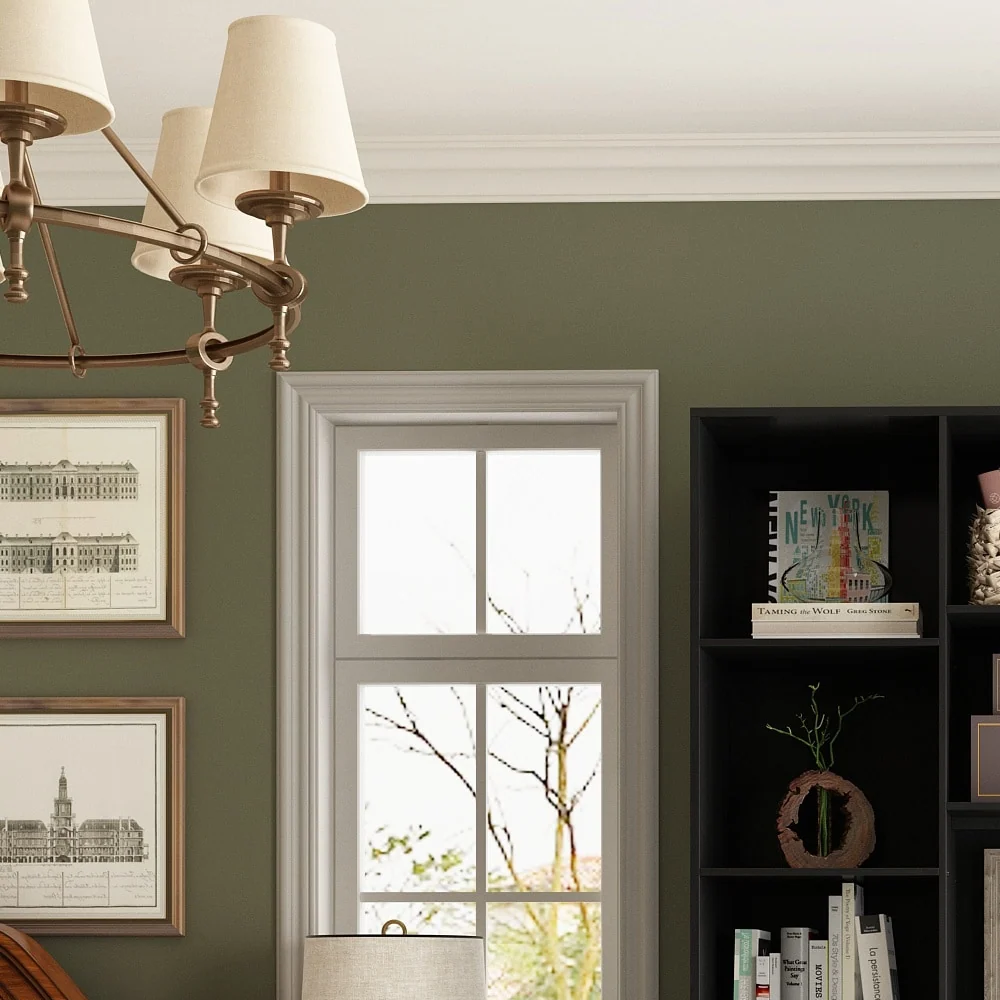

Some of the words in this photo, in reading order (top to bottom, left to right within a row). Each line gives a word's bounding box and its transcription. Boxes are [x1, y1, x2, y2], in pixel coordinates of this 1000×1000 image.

[785, 499, 824, 545] NEW
[799, 607, 811, 615] the
[831, 933, 839, 947] 70s
[830, 947, 839, 968] Style
[868, 947, 879, 957] La
[831, 968, 839, 976] &
[815, 964, 823, 999] MOVIES
